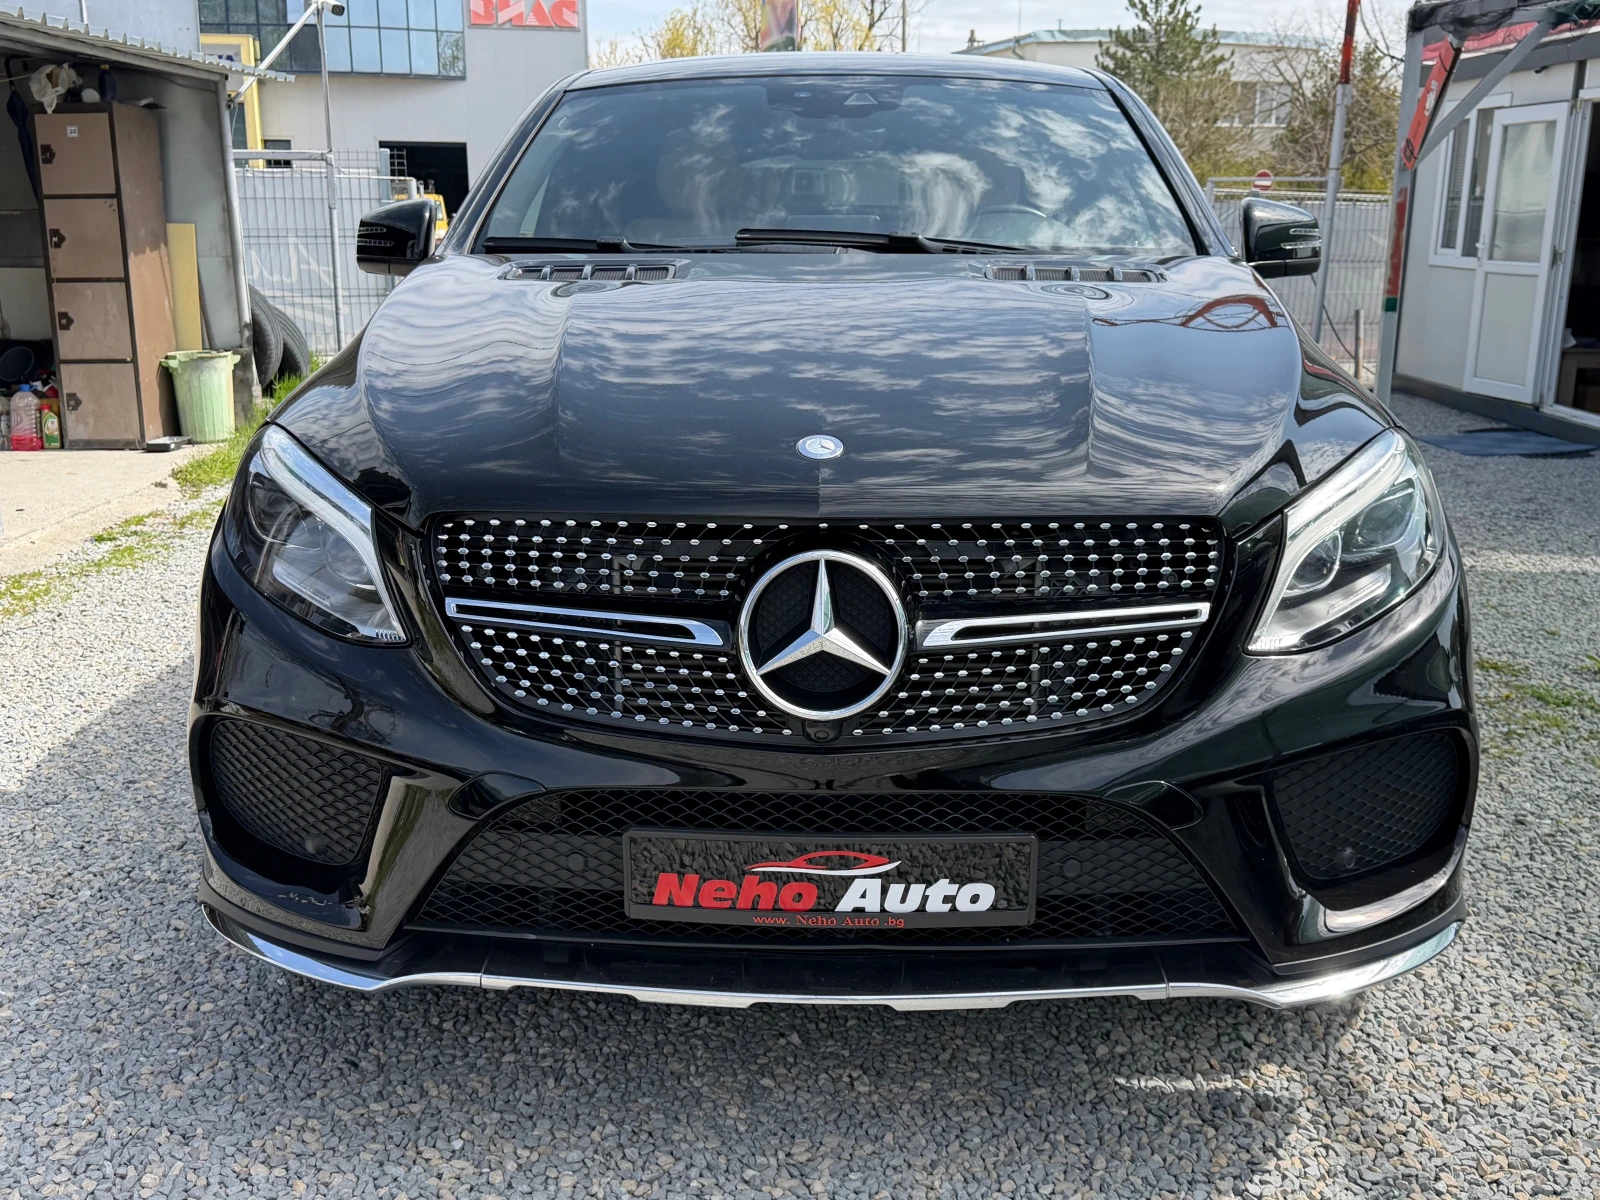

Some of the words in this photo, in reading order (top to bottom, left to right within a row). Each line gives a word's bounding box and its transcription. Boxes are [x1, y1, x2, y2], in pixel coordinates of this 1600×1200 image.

[652, 872, 818, 912] Neho
[834, 878, 996, 913] Auto
[752, 916, 791, 925] www.
[796, 914, 837, 926] Neho
[841, 916, 880, 926] Auto
[884, 916, 905, 928] .bg
